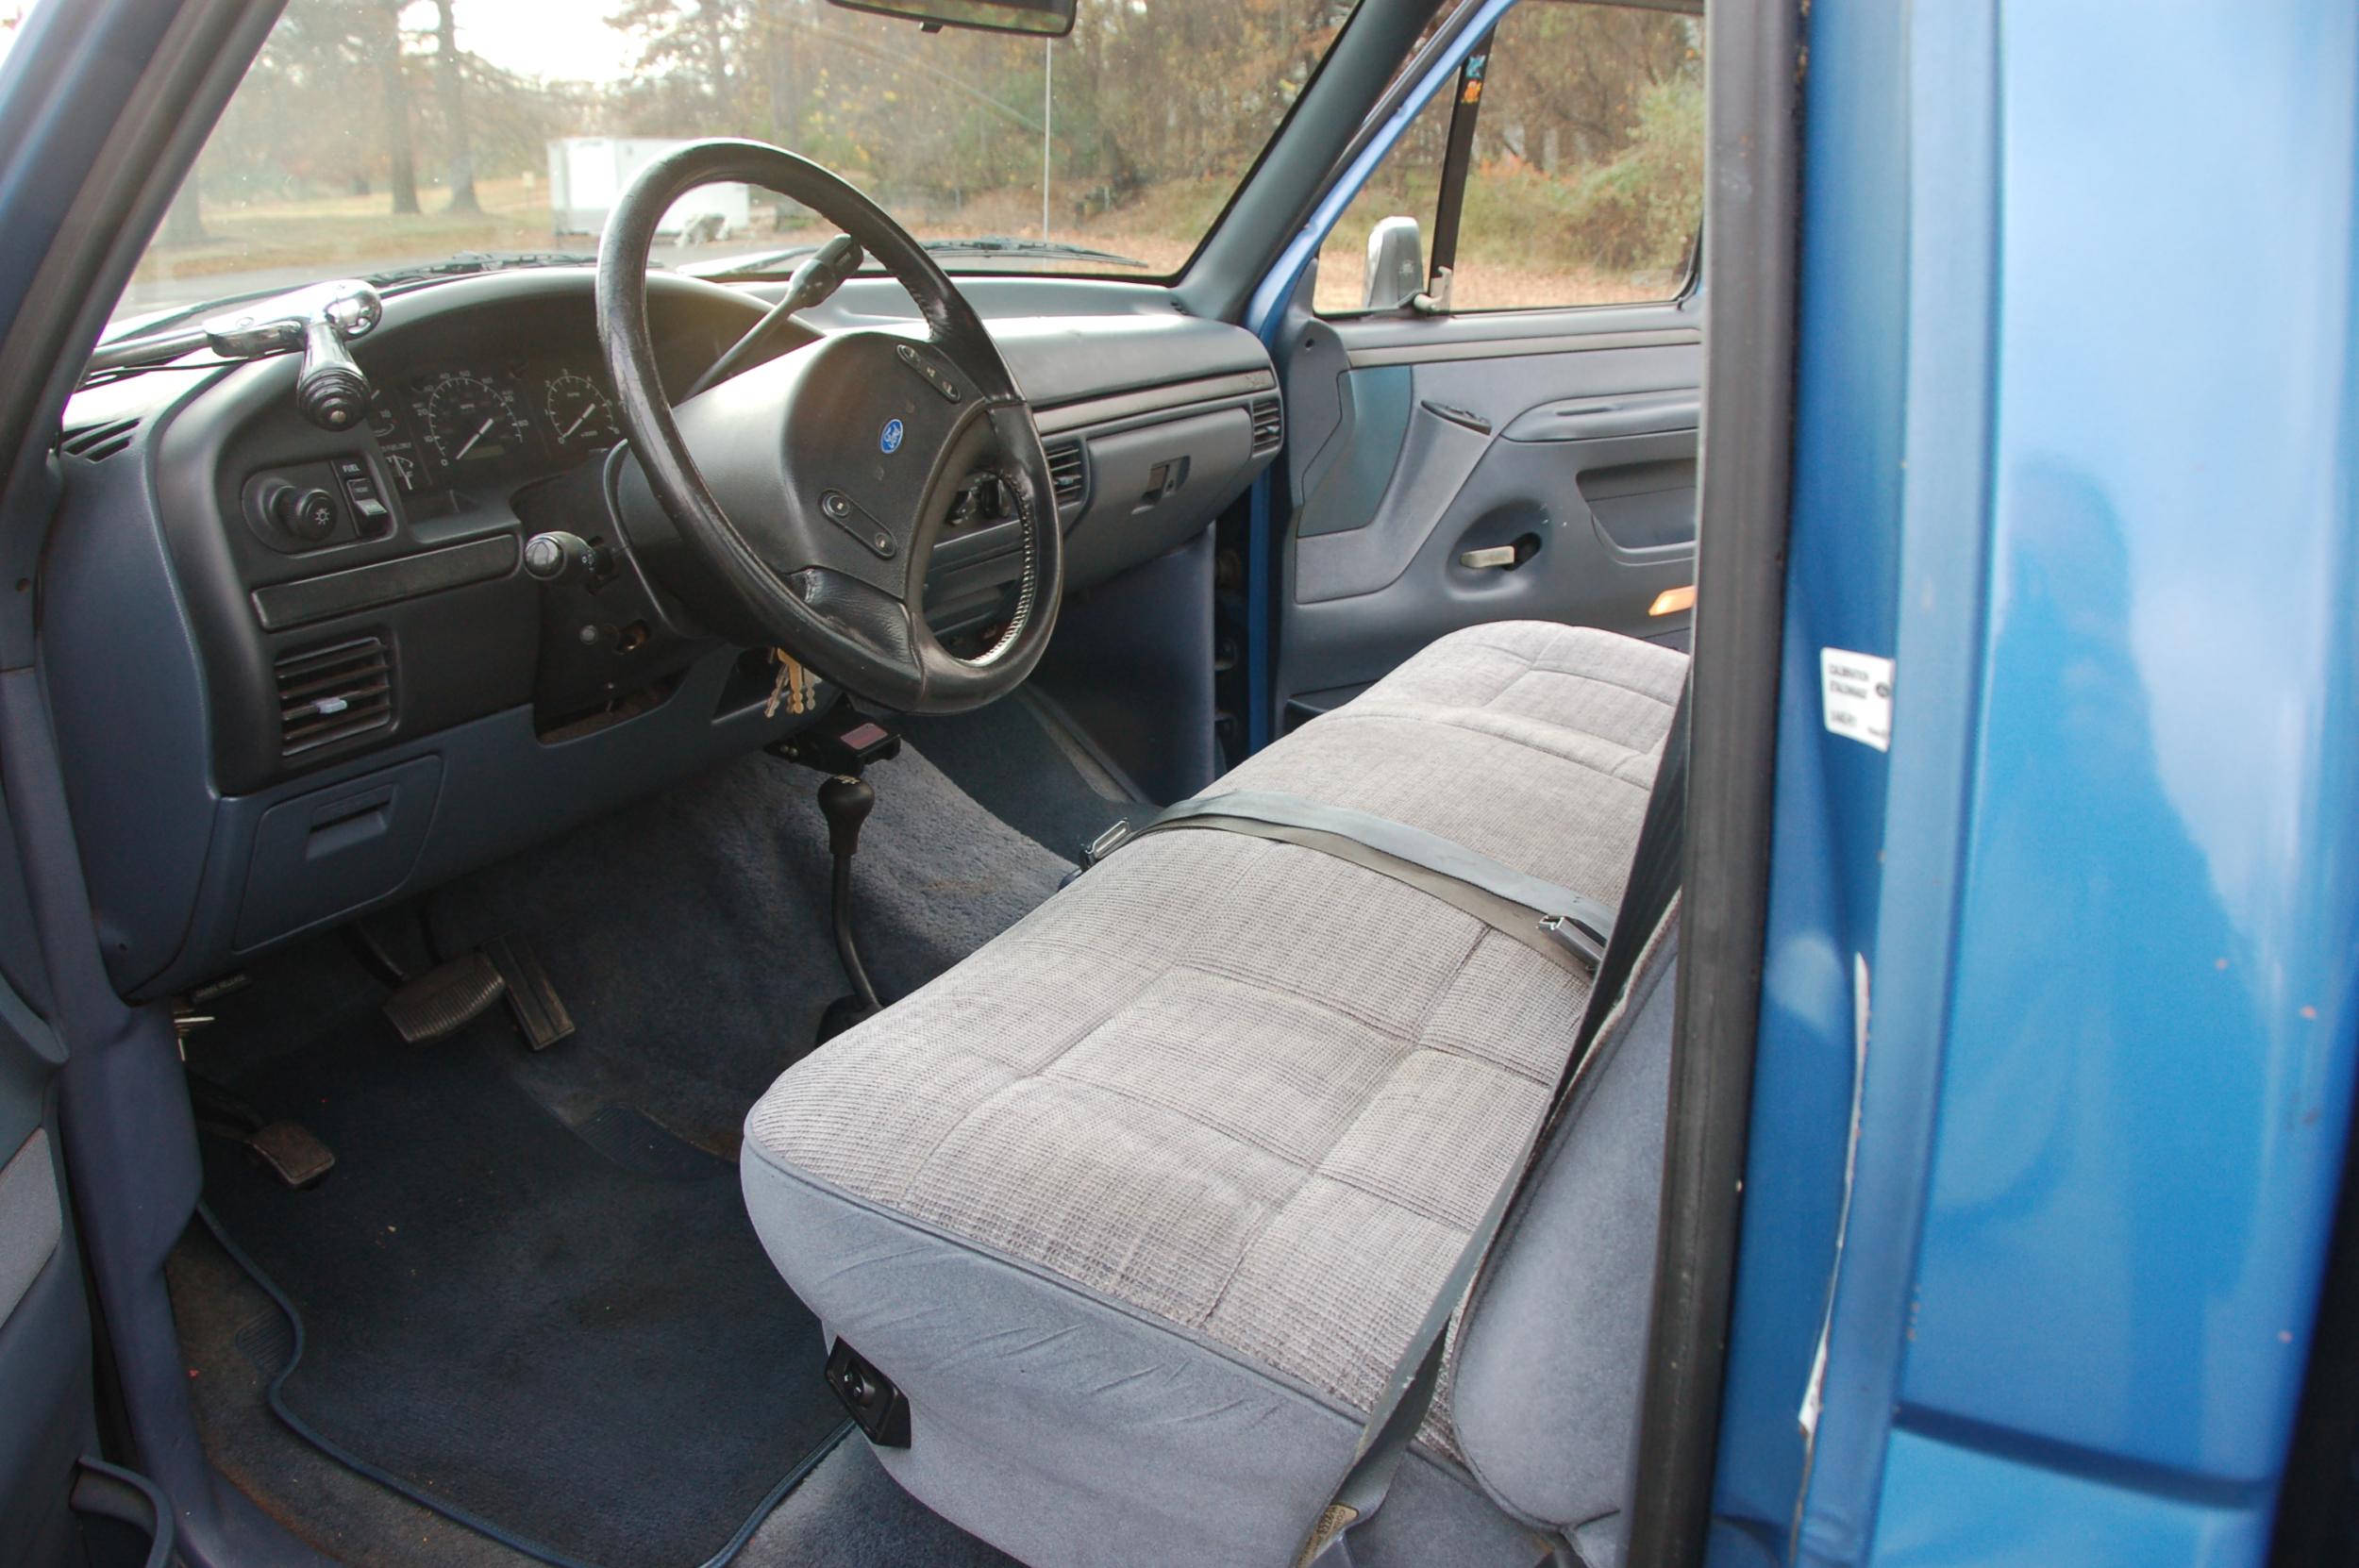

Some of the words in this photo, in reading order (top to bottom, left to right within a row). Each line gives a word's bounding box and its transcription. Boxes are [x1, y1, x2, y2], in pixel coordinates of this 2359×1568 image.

[416, 408, 428, 417] 20
[440, 459, 449, 467] 0
[342, 463, 361, 474] FUEL
